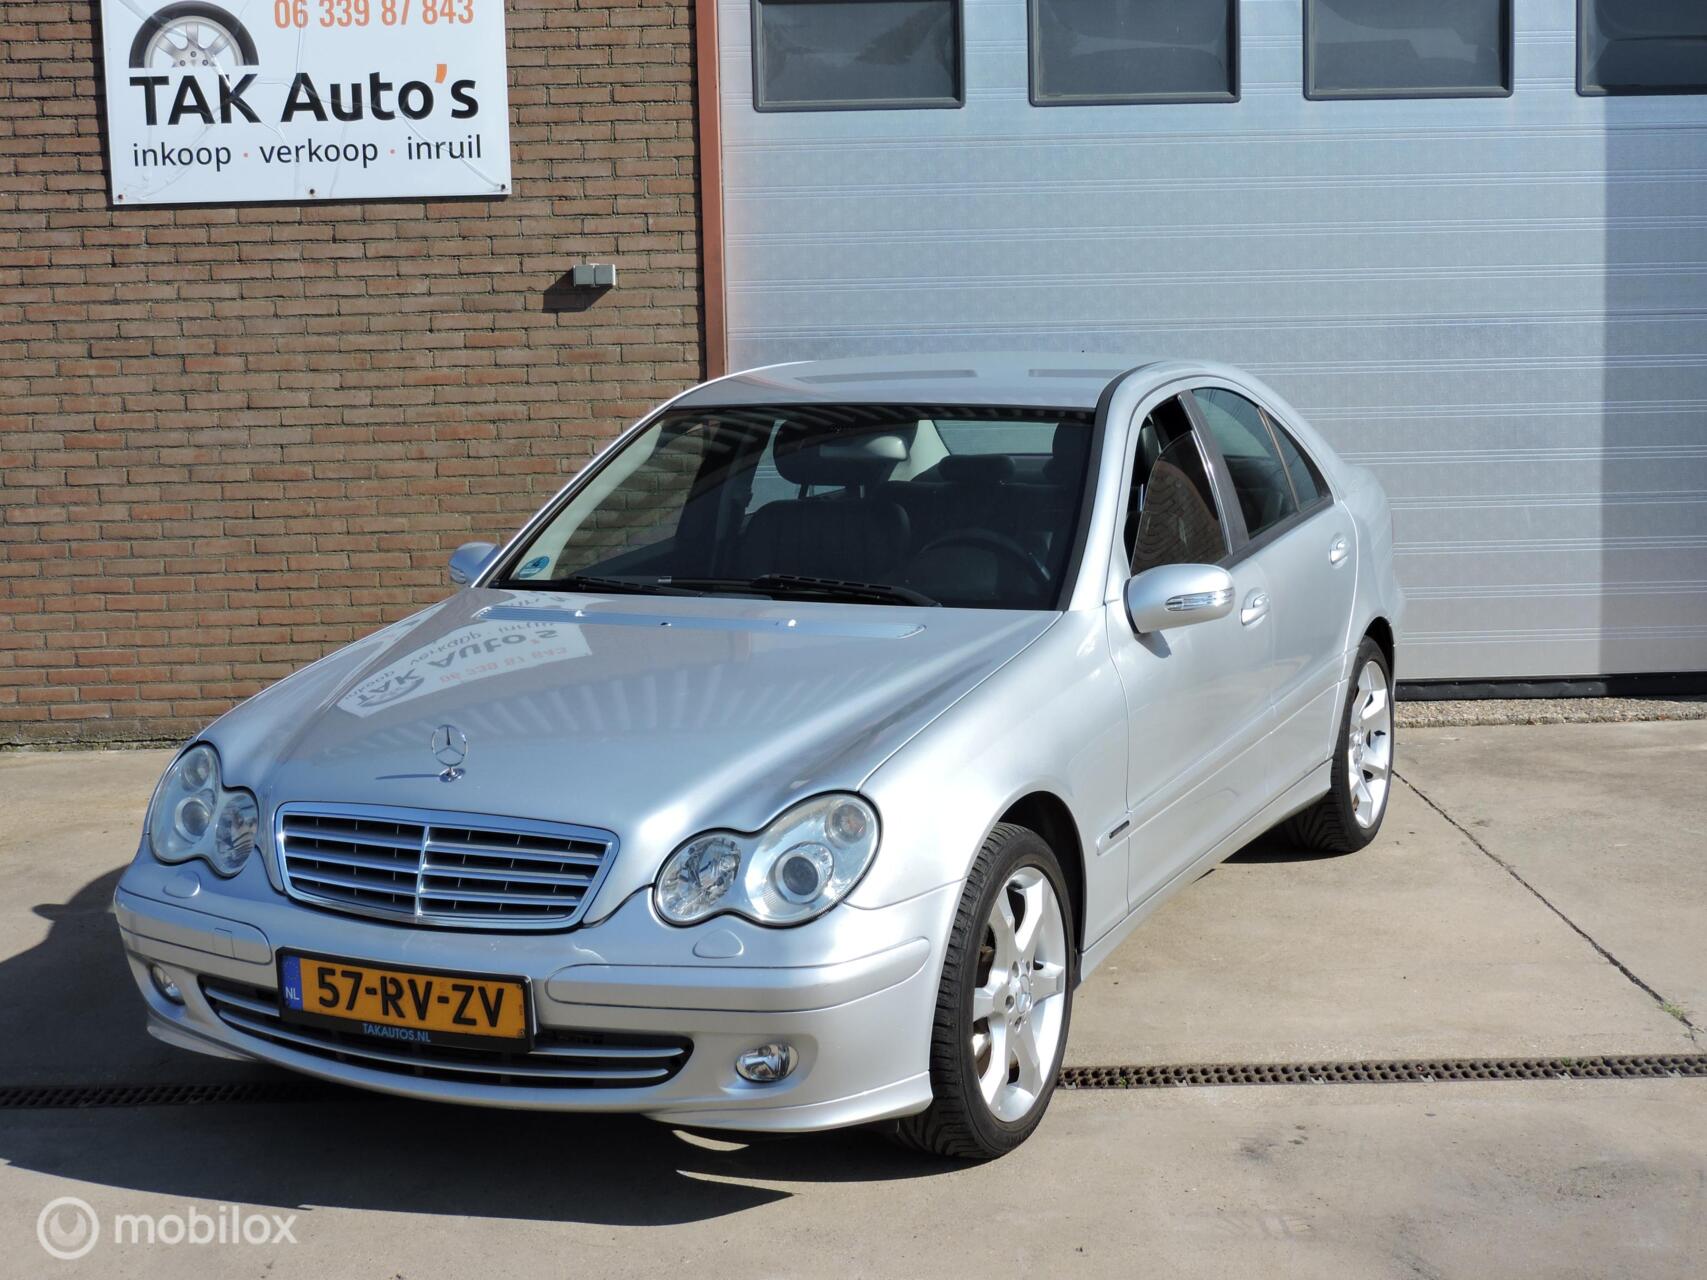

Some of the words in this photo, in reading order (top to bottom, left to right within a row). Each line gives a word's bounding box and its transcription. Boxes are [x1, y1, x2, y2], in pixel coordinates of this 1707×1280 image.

[274, 0, 308, 28] 06
[319, 0, 370, 27] 339
[381, 0, 410, 25] 87
[422, 0, 474, 24] 843
[129, 73, 261, 126] TAK
[133, 141, 231, 171] inkoop
[260, 138, 378, 168] verkoop
[407, 134, 481, 160] inruil
[285, 986, 300, 1001] NL
[317, 967, 504, 1027] 57-RV-ZV
[363, 1023, 431, 1042] TAKAUTOS.NL
